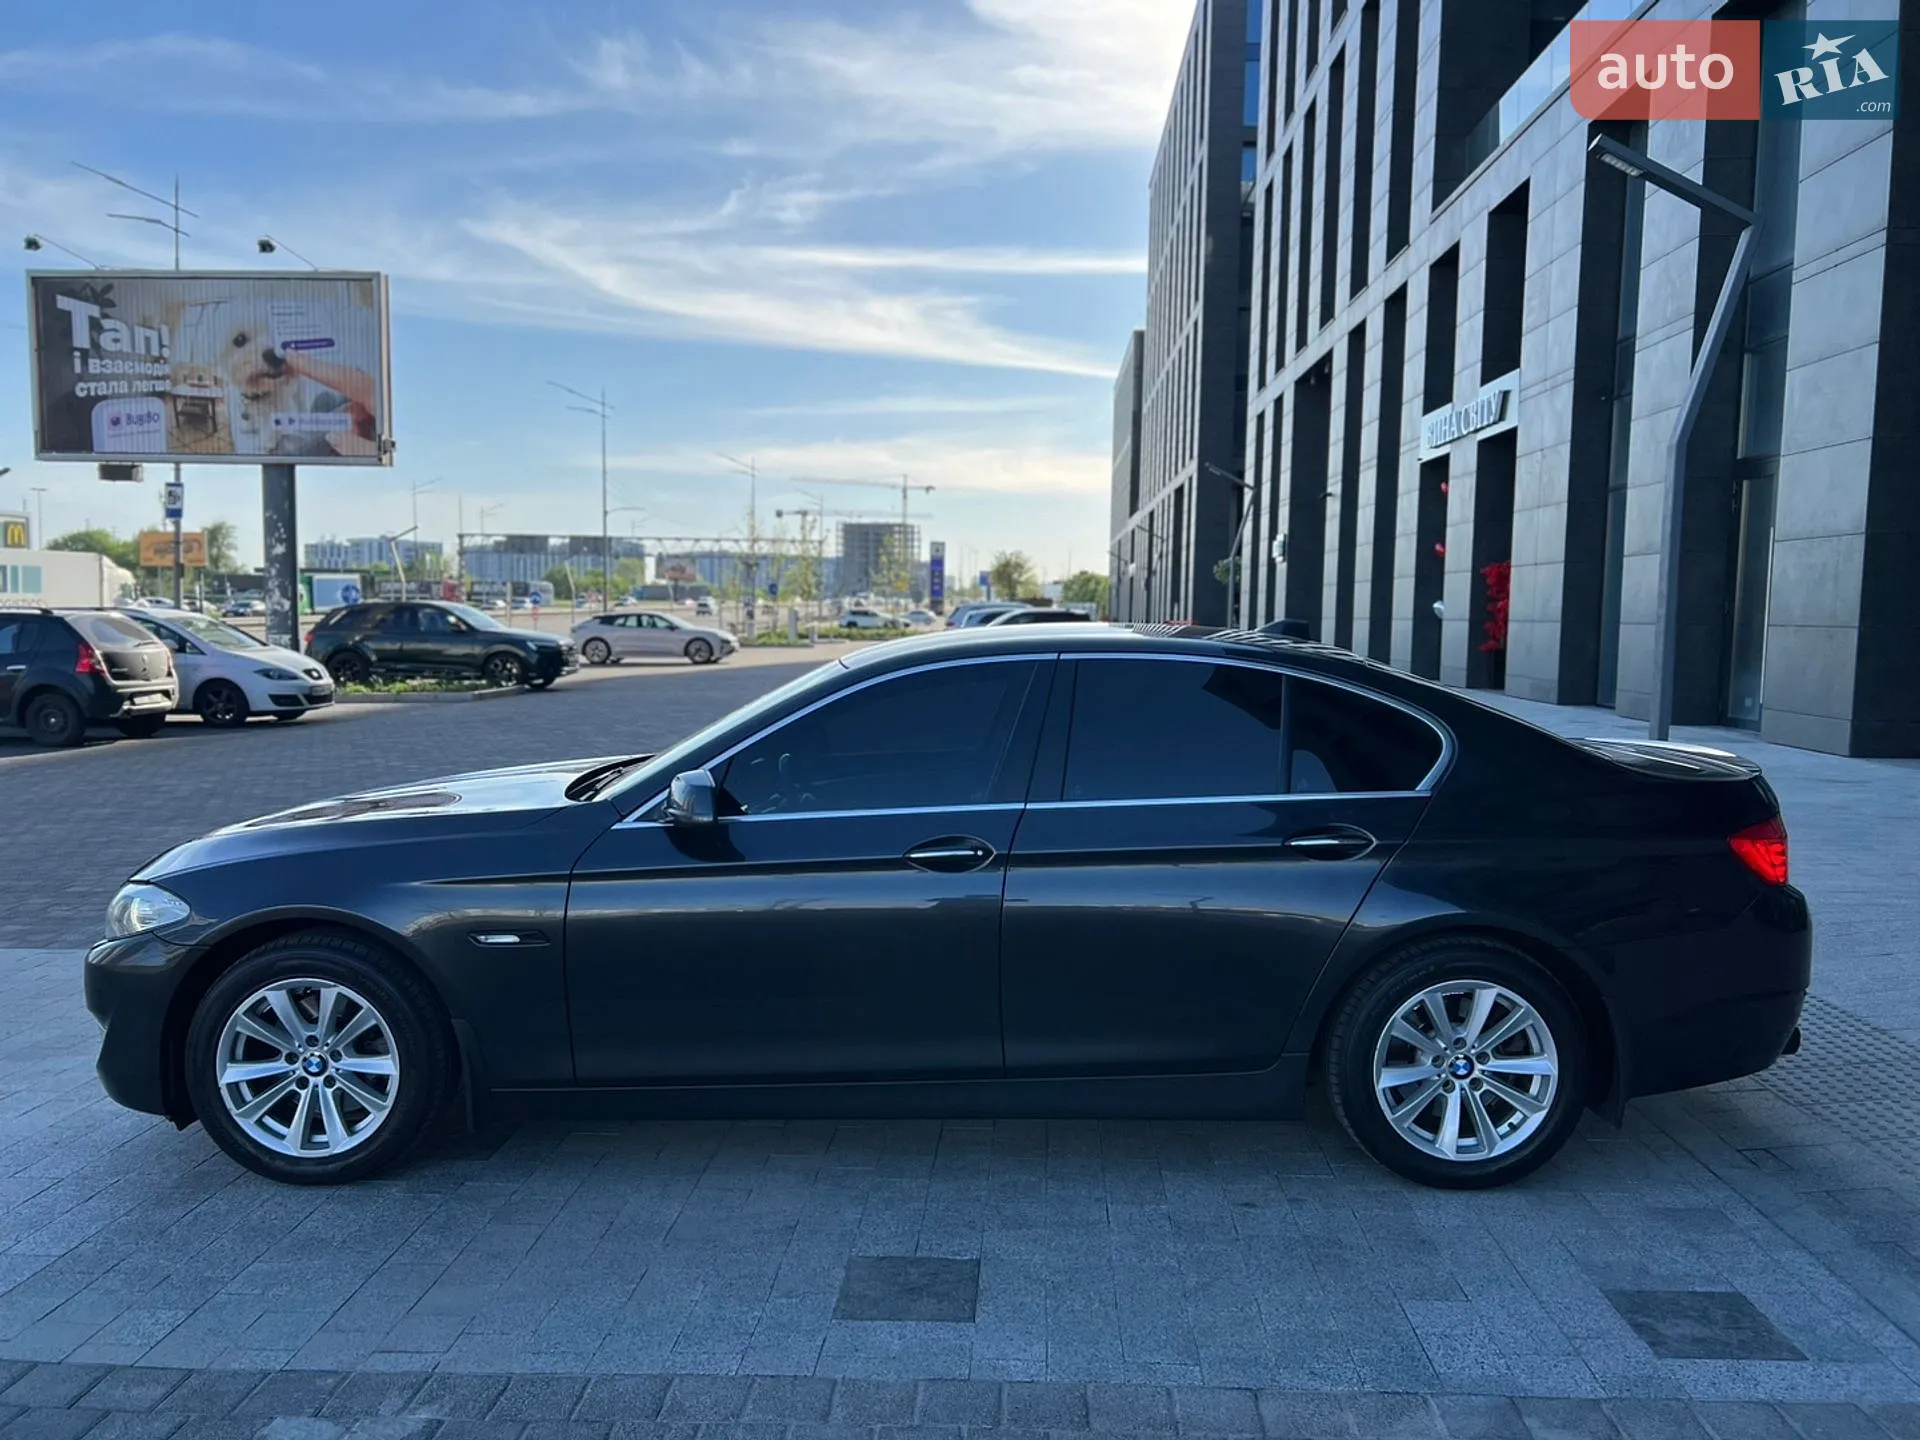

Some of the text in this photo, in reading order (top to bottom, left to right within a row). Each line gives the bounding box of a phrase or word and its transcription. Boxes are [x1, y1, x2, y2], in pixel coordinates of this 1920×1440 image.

[56, 294, 170, 358] Тап!
[72, 350, 81, 374] і
[75, 380, 128, 398] стала
